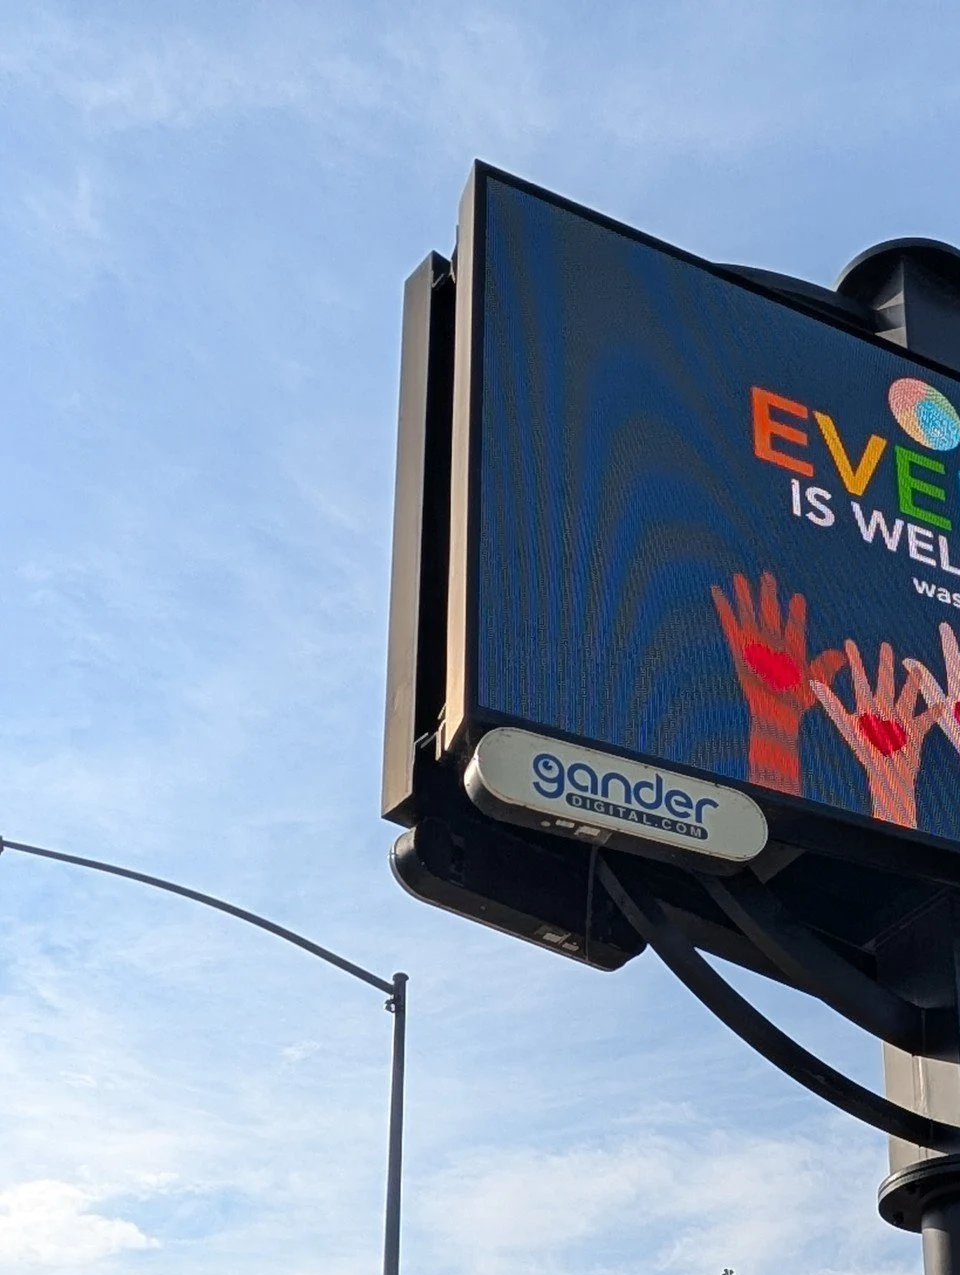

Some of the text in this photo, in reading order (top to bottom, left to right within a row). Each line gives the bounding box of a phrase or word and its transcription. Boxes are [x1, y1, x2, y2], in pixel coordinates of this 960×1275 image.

[790, 479, 836, 528] IS
[532, 752, 720, 824] gander
[571, 794, 704, 838] DIGITAL.COM
